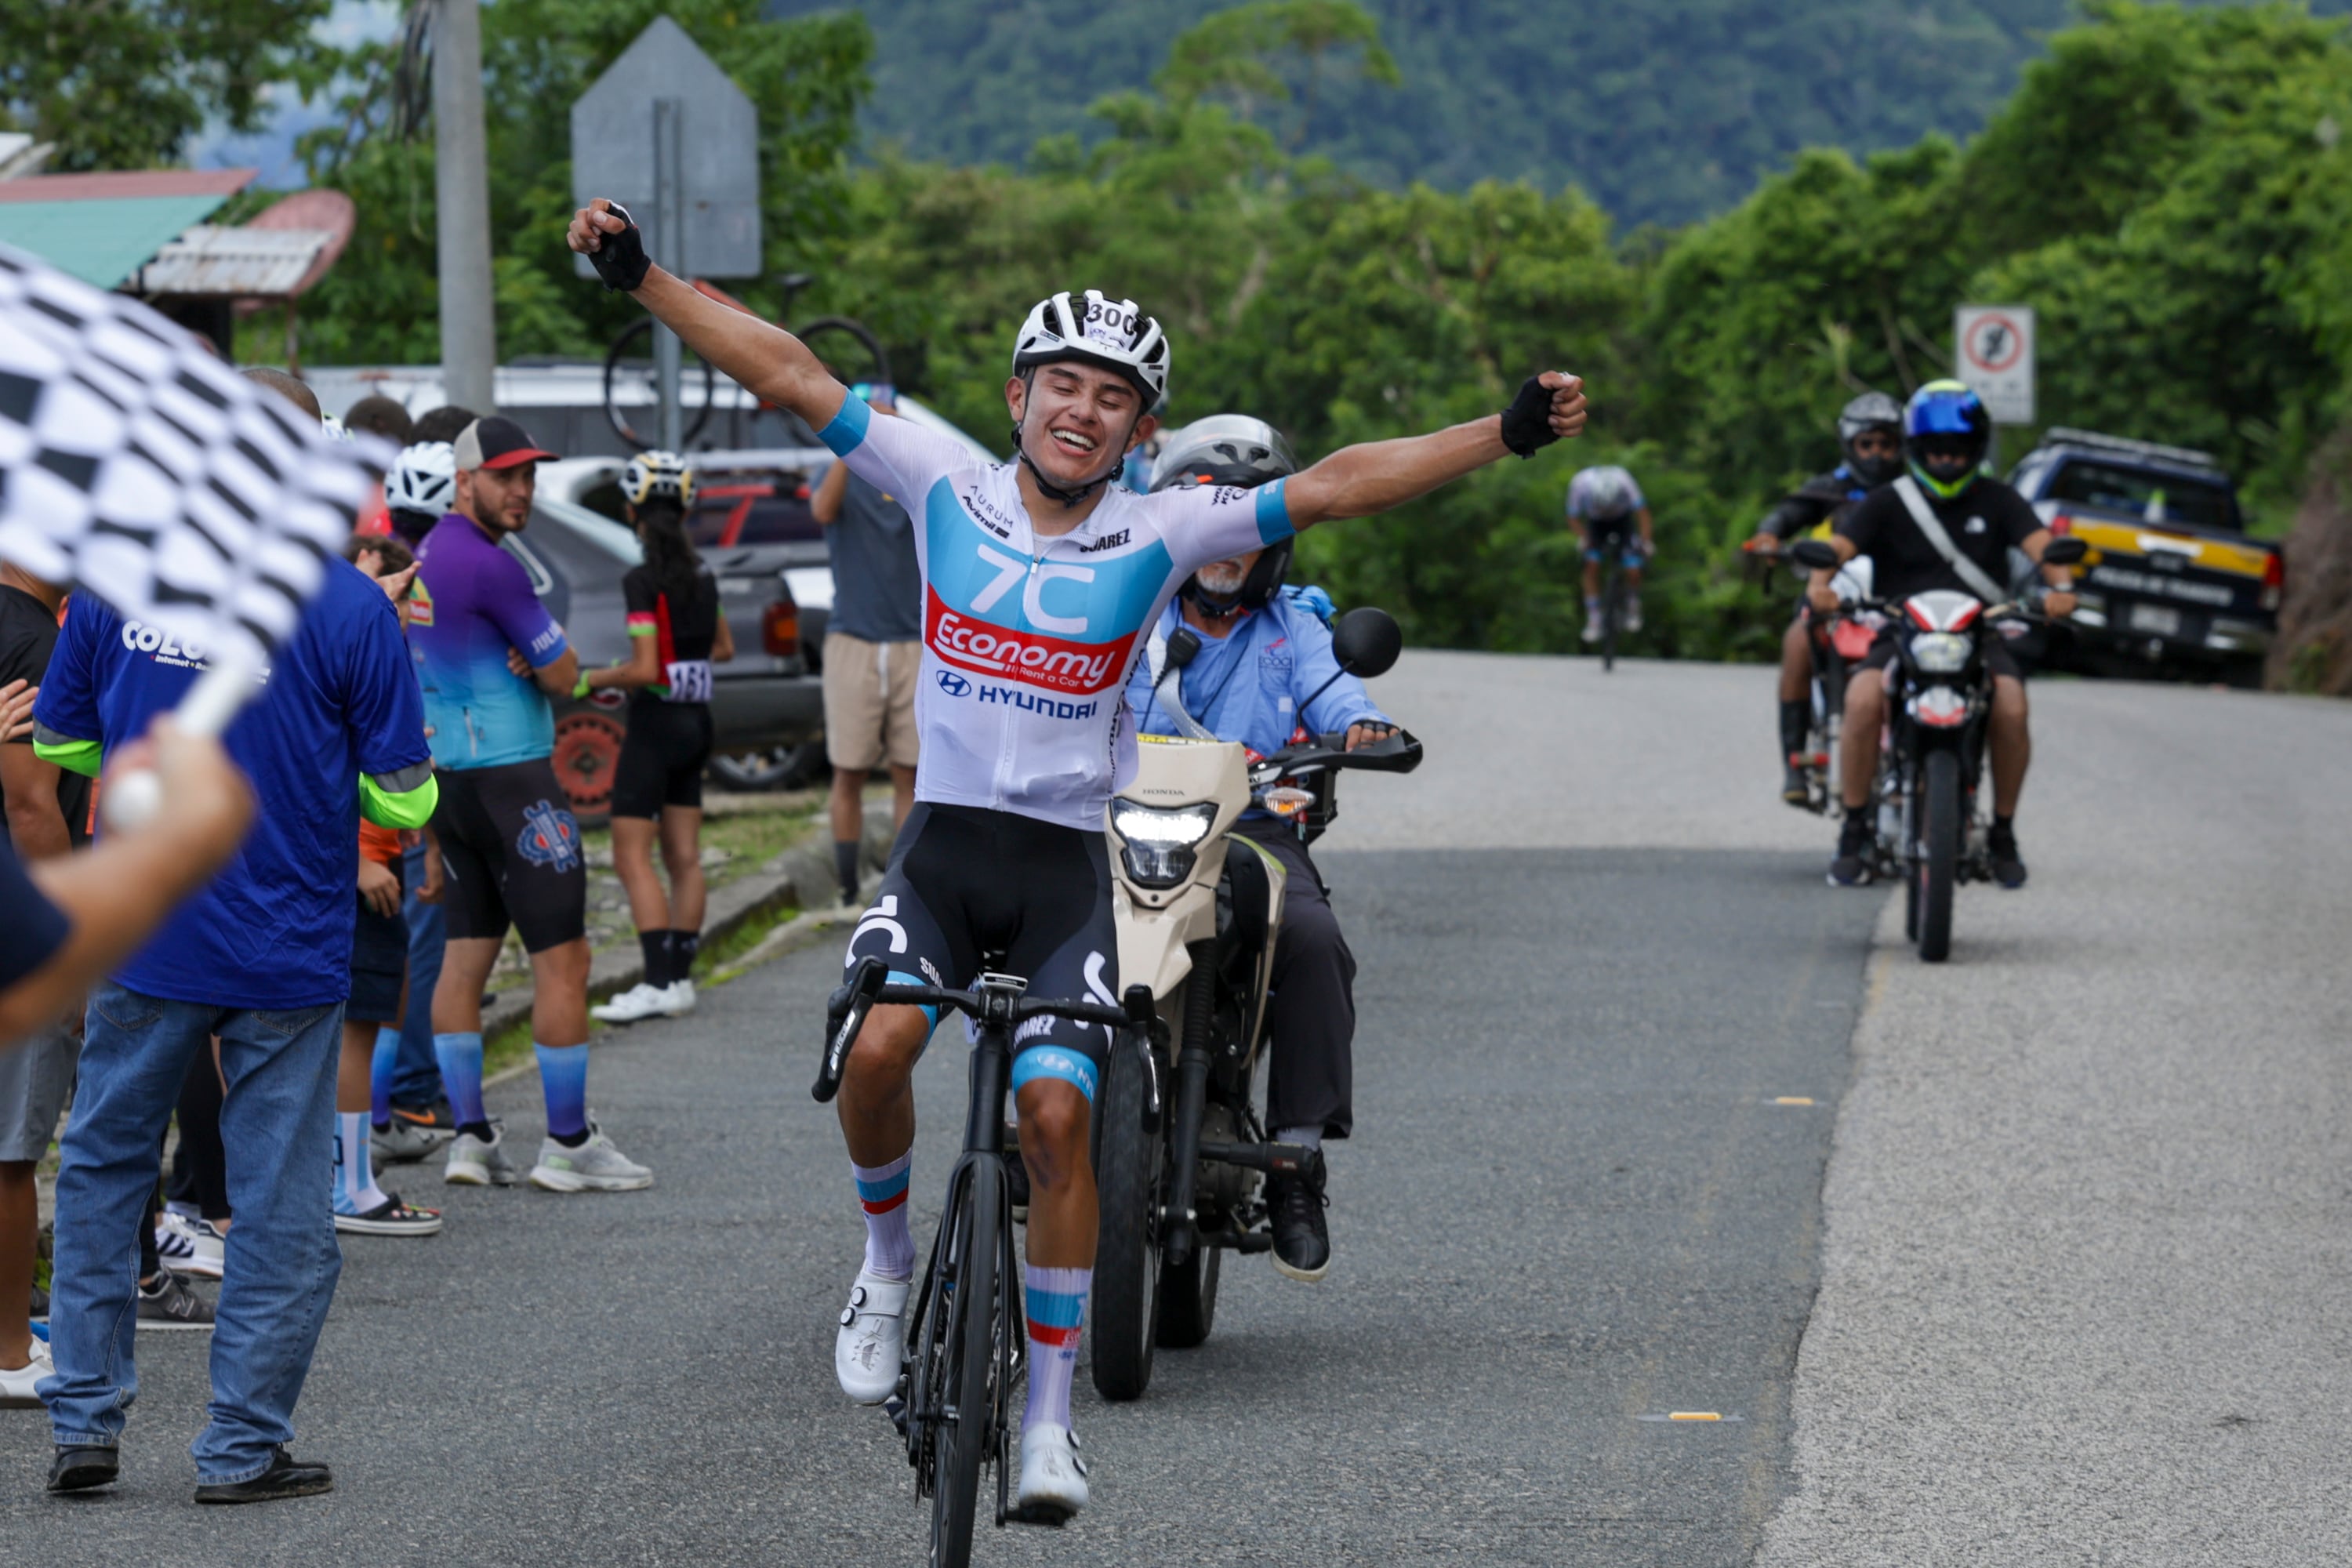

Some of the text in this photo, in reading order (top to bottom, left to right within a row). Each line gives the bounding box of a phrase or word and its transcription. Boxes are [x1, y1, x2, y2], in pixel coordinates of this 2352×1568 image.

[1086, 303, 1134, 336] 300
[962, 495, 996, 530] Avimil
[971, 485, 1014, 528] AURUM
[970, 543, 1095, 634] 7C
[155, 654, 190, 668] Internet
[937, 612, 1116, 688] Economy
[1019, 667, 1044, 681] Rent
[1059, 676, 1080, 688] Car
[979, 685, 1097, 720] HYUNDAI
